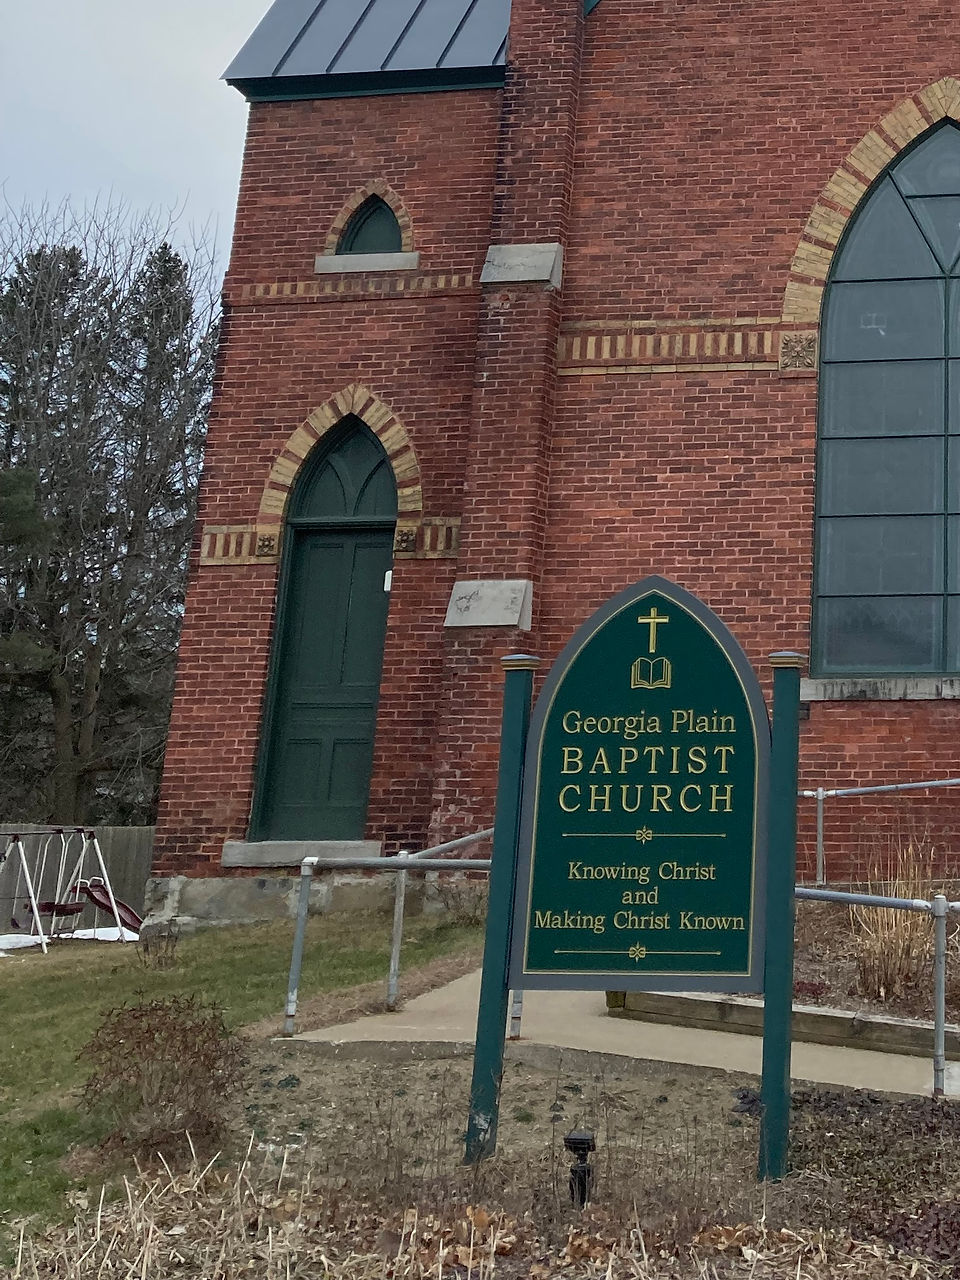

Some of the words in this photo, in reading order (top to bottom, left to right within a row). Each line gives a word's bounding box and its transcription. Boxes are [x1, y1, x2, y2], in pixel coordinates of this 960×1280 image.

[562, 710, 661, 739] Georgia
[671, 709, 736, 733] Plain
[560, 746, 736, 774] BAPTIST
[558, 784, 734, 813] CHURCH
[567, 862, 650, 883] Knowing
[658, 862, 716, 880] Christ
[622, 887, 659, 904] and
[534, 911, 605, 933] Making
[613, 911, 670, 930] Christ
[679, 912, 745, 930] Known
